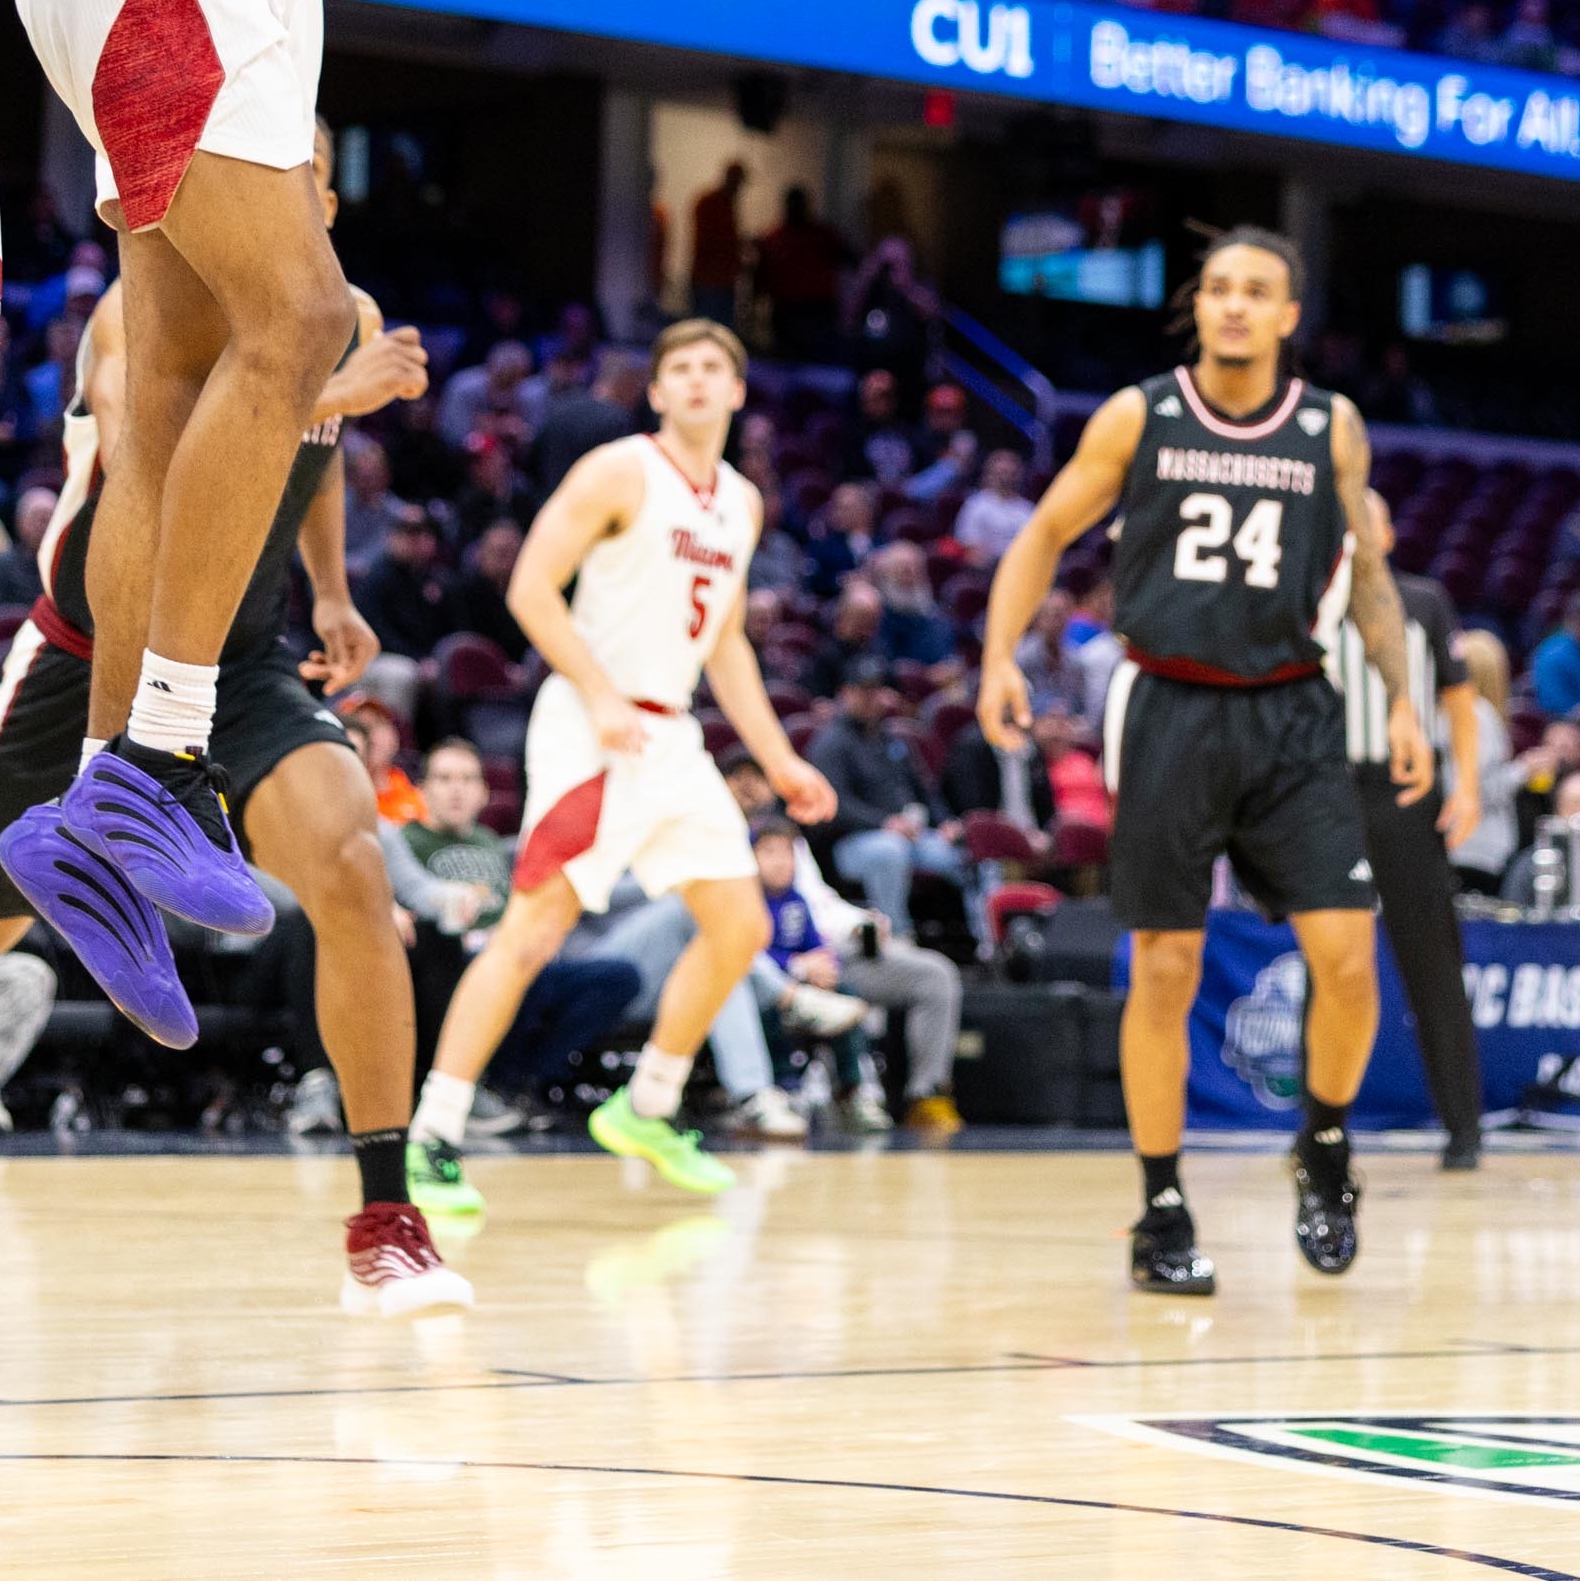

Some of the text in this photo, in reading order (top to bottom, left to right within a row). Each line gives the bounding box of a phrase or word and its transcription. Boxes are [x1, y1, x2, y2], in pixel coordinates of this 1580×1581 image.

[1090, 20, 1237, 104] Better
[1245, 44, 1430, 147] Banking
[1436, 75, 1515, 145] For
[1156, 446, 1316, 496] MASSACHUSETTS
[1173, 491, 1283, 590] 24
[689, 575, 711, 639] 5
